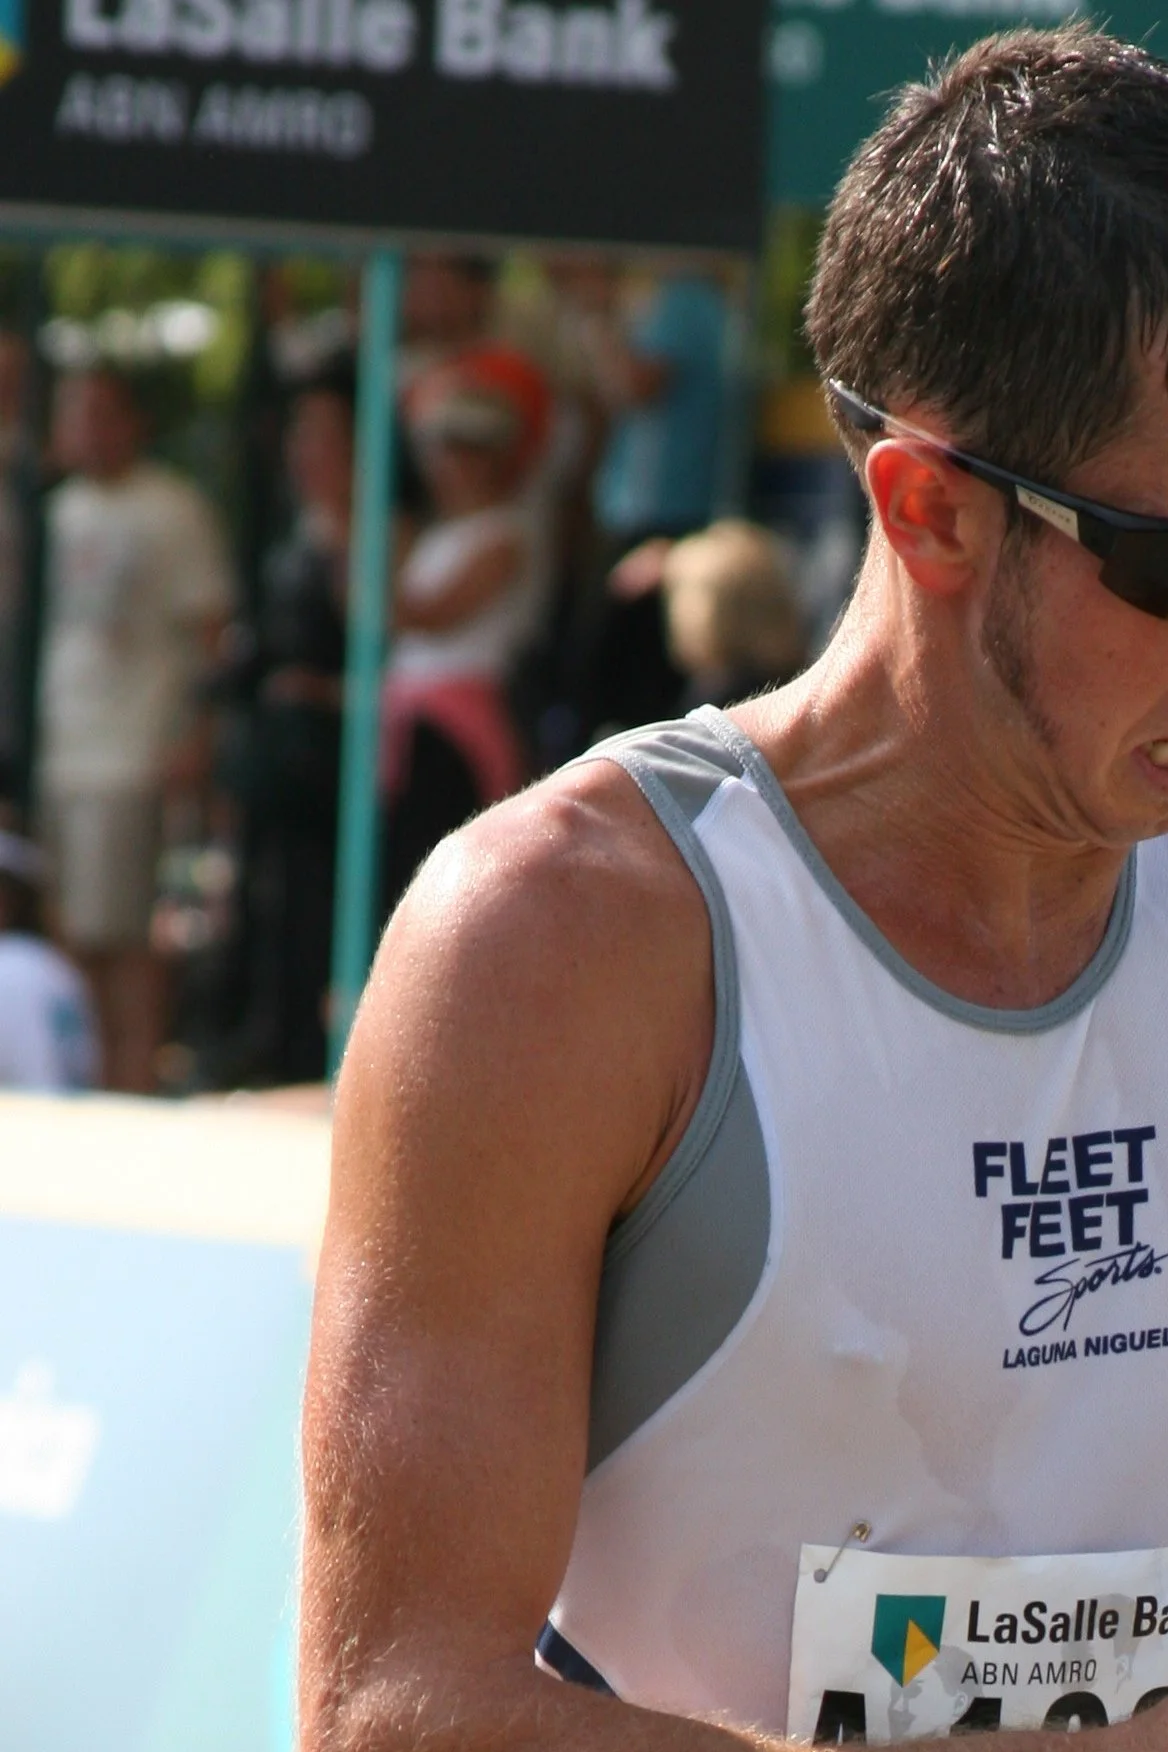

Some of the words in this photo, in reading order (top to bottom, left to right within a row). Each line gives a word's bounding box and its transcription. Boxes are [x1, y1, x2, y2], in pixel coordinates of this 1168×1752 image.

[434, 0, 677, 88] Bank
[57, 70, 186, 143] ABN
[192, 80, 375, 160] AMRO
[973, 1126, 1156, 1198] FLEET
[1001, 1189, 1149, 1259] FEET
[1002, 1341, 1077, 1369] LAGUNA
[967, 1598, 1120, 1645] LaSalle
[961, 1662, 1018, 1686] ABN
[1028, 1659, 1097, 1686] AMRO
